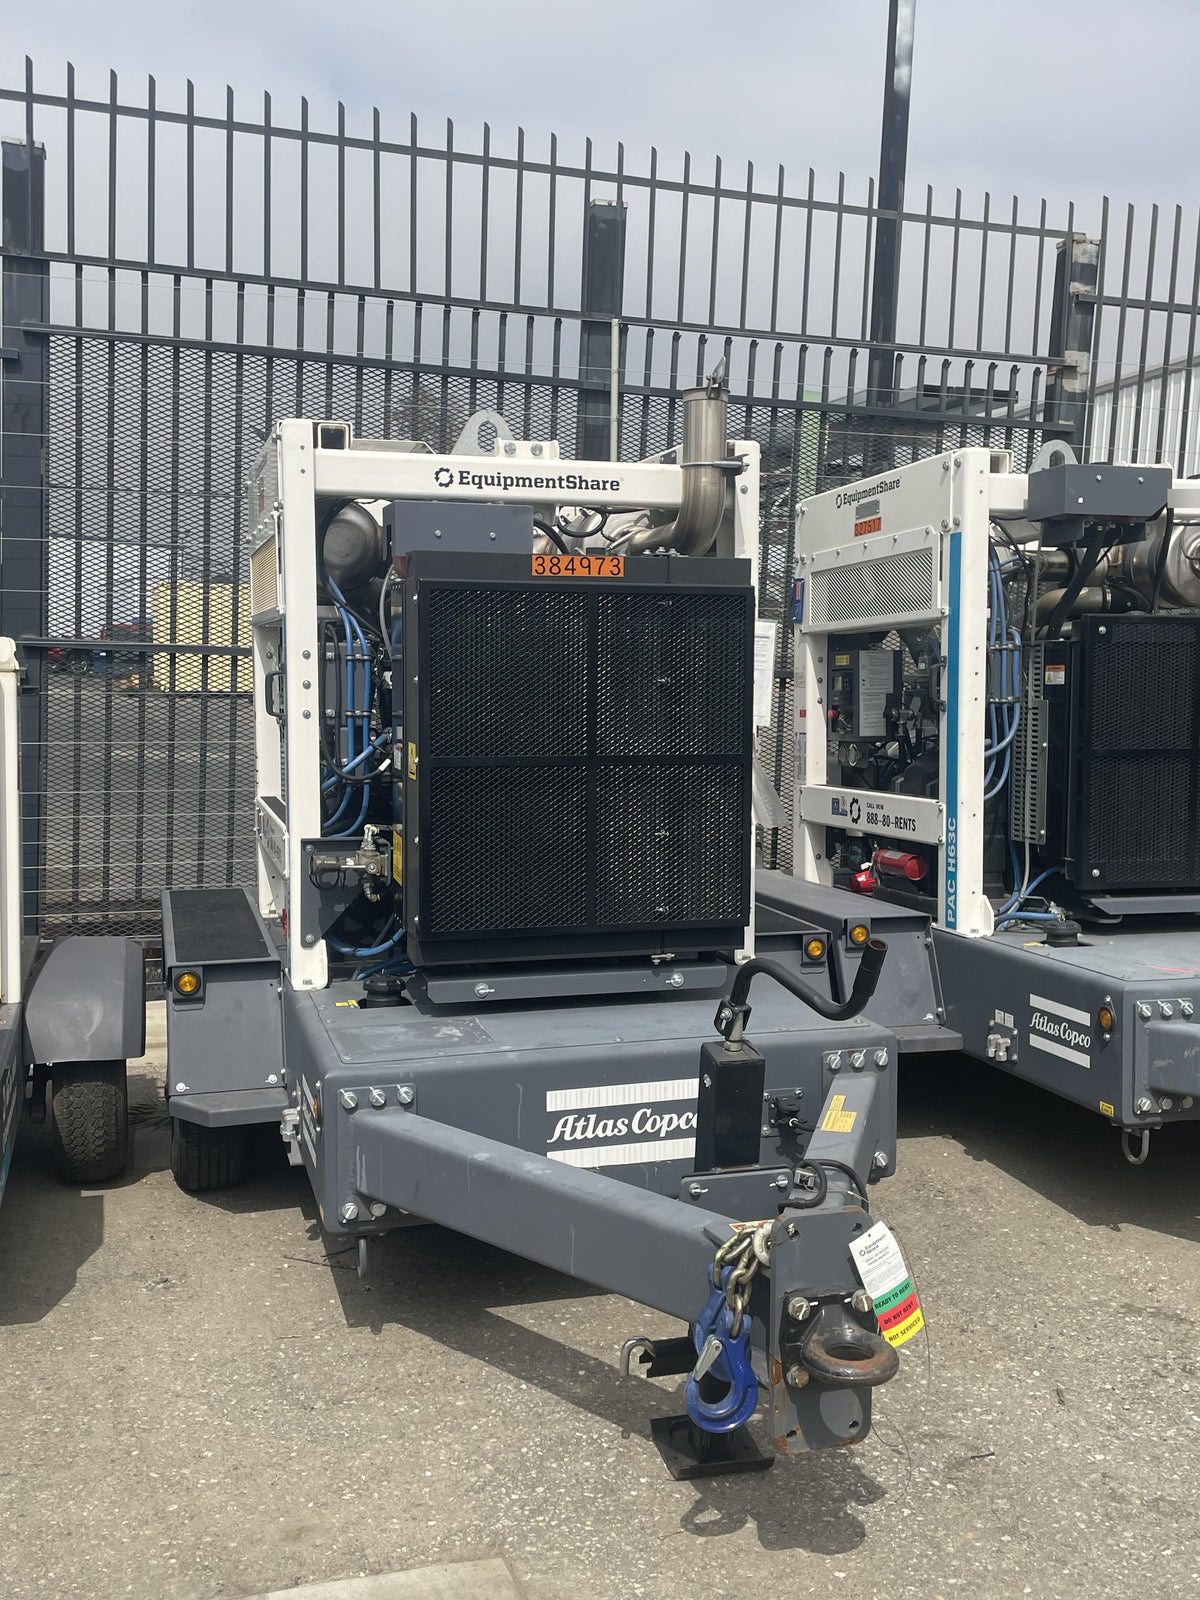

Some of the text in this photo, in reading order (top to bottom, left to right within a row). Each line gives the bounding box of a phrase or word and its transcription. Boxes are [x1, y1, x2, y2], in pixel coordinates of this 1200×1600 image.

[458, 470, 620, 491] EquipmentShare
[843, 478, 901, 506] EquipmentShare
[534, 556, 621, 576] 384973
[866, 812, 917, 832] 888-80-RENTS
[947, 817, 956, 923] PAC H63C
[1029, 1012, 1060, 1037] Atlas
[1059, 1022, 1091, 1048] Copco
[546, 1113, 629, 1143] Atlas
[874, 1282, 910, 1310] READY TO RENT
[883, 1301, 914, 1325] DO NOT RENT
[888, 1333, 900, 1343] NOT
